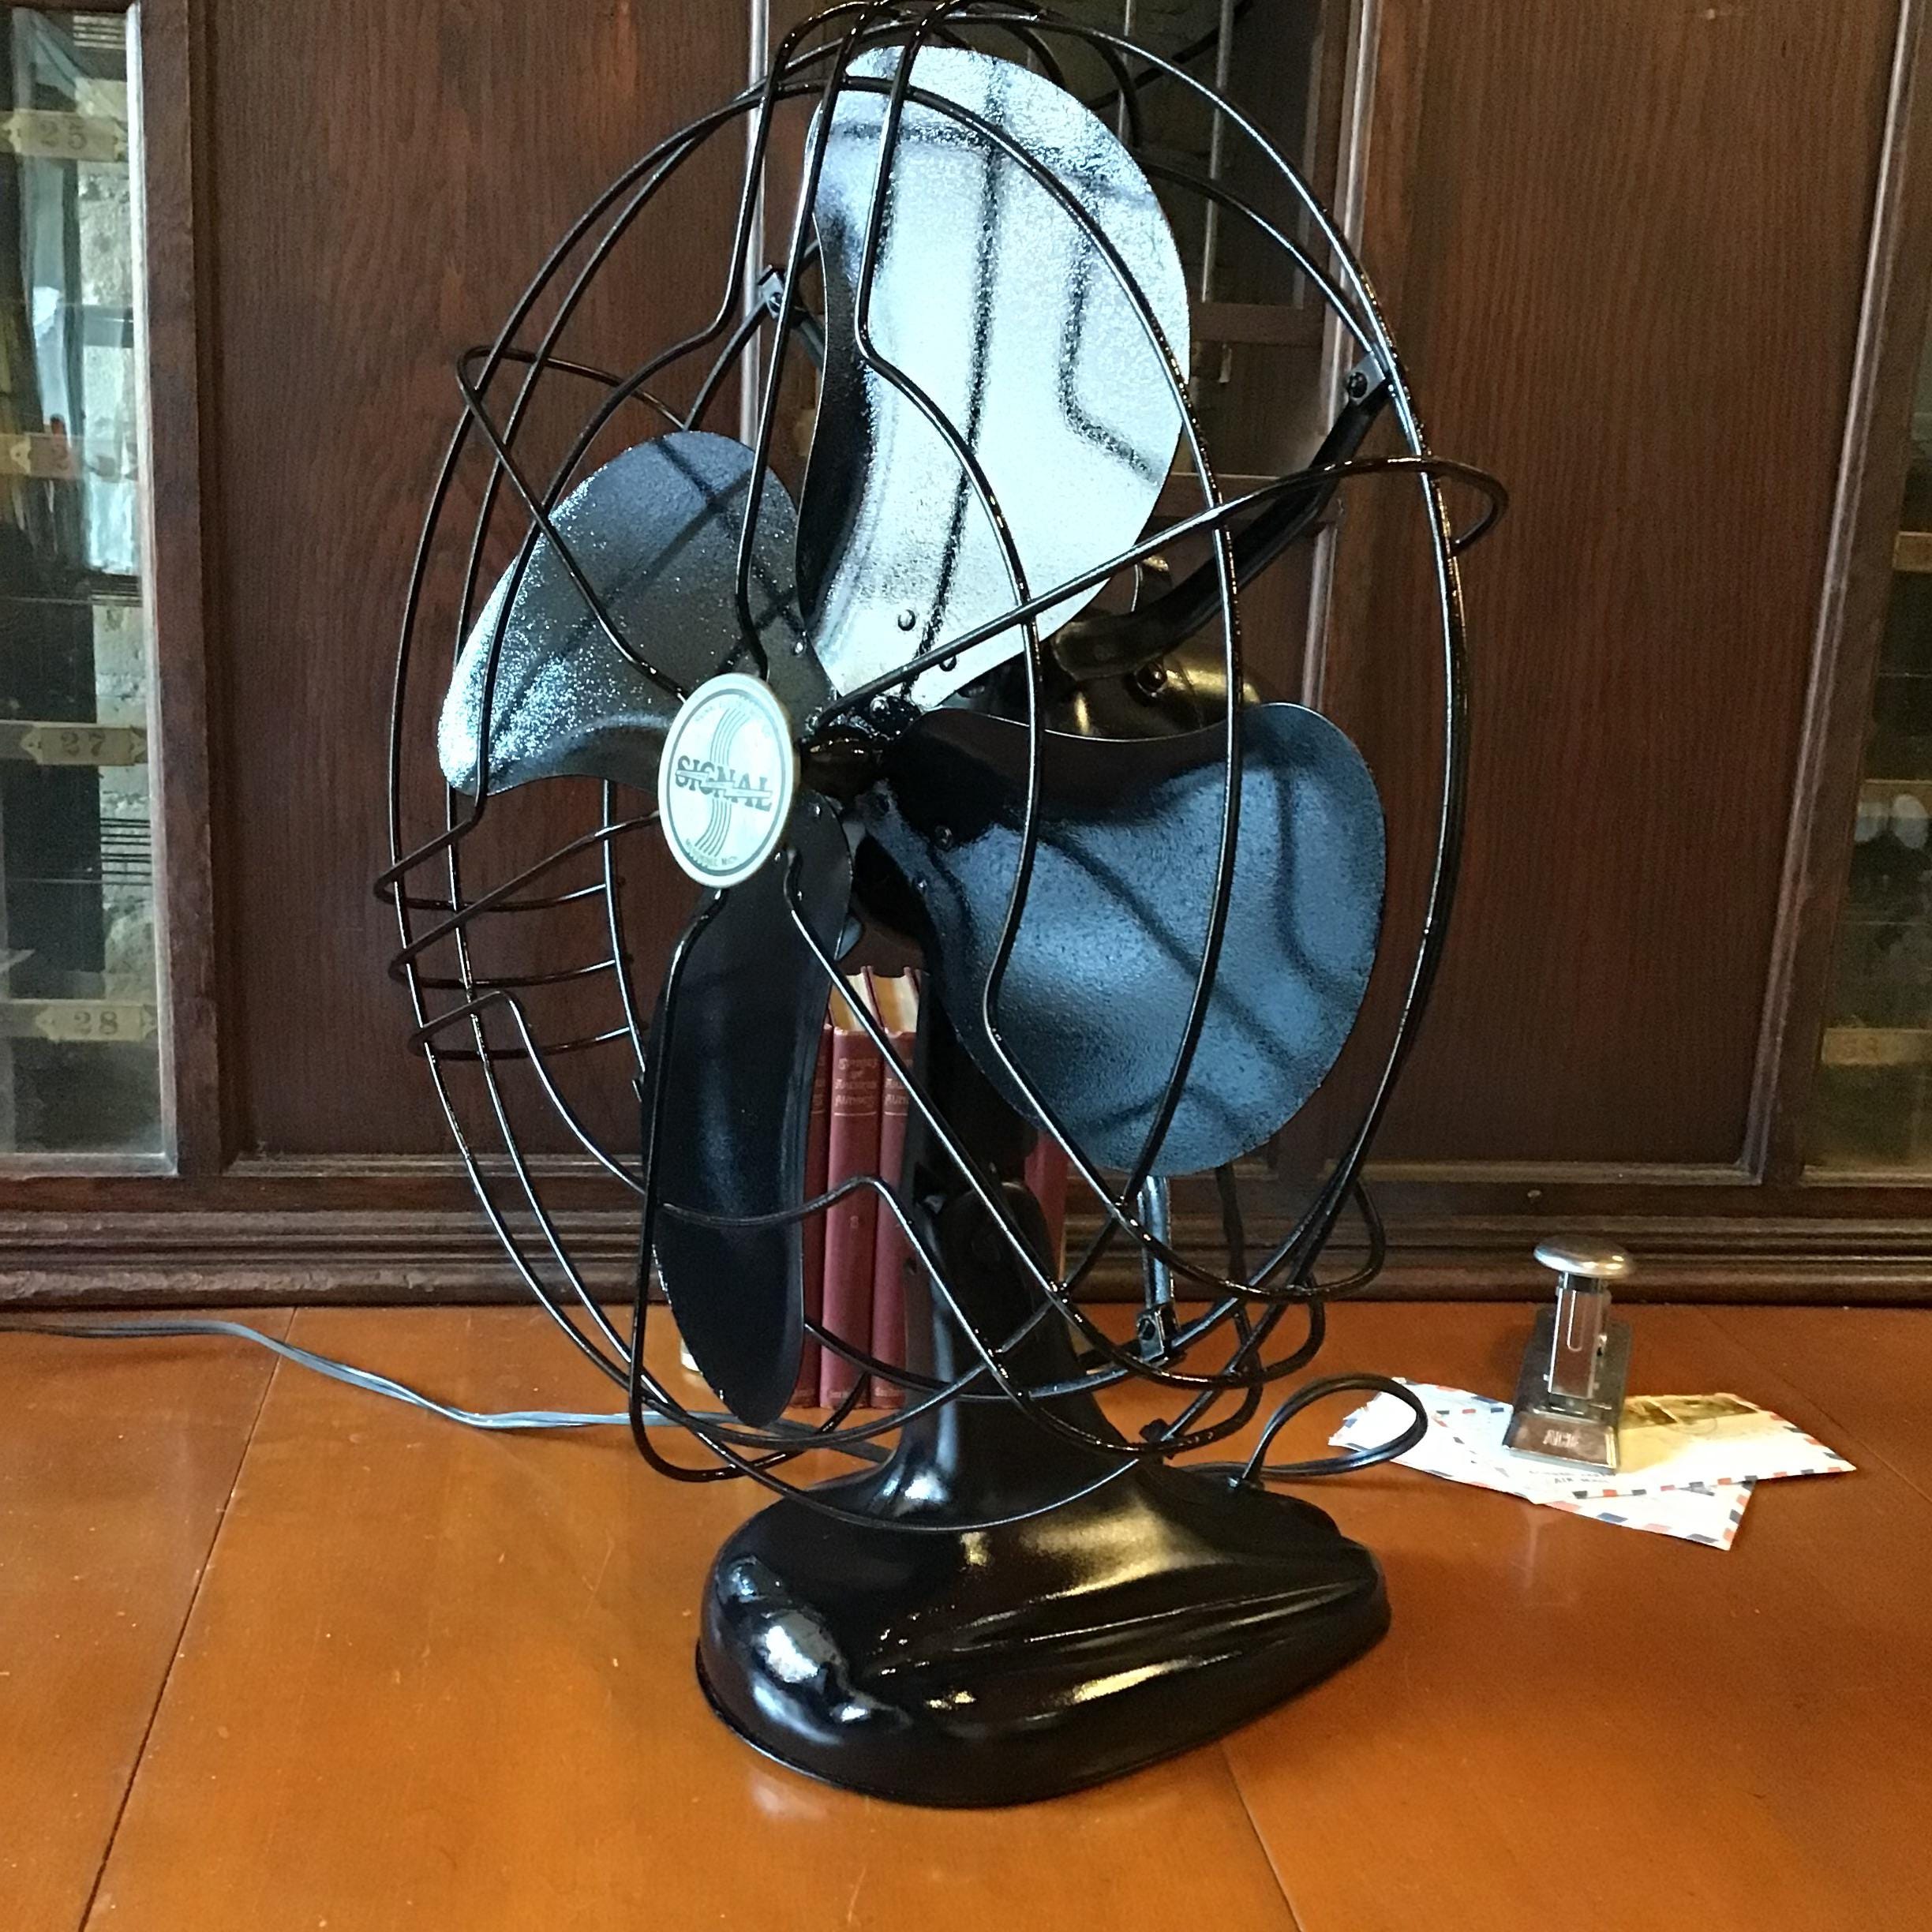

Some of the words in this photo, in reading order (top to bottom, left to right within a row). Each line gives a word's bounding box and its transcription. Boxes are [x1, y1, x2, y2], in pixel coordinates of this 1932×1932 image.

[38, 121, 88, 150] 25
[61, 732, 103, 757] 27
[676, 755, 773, 811] SIGNAL
[74, 1011, 118, 1035] 28
